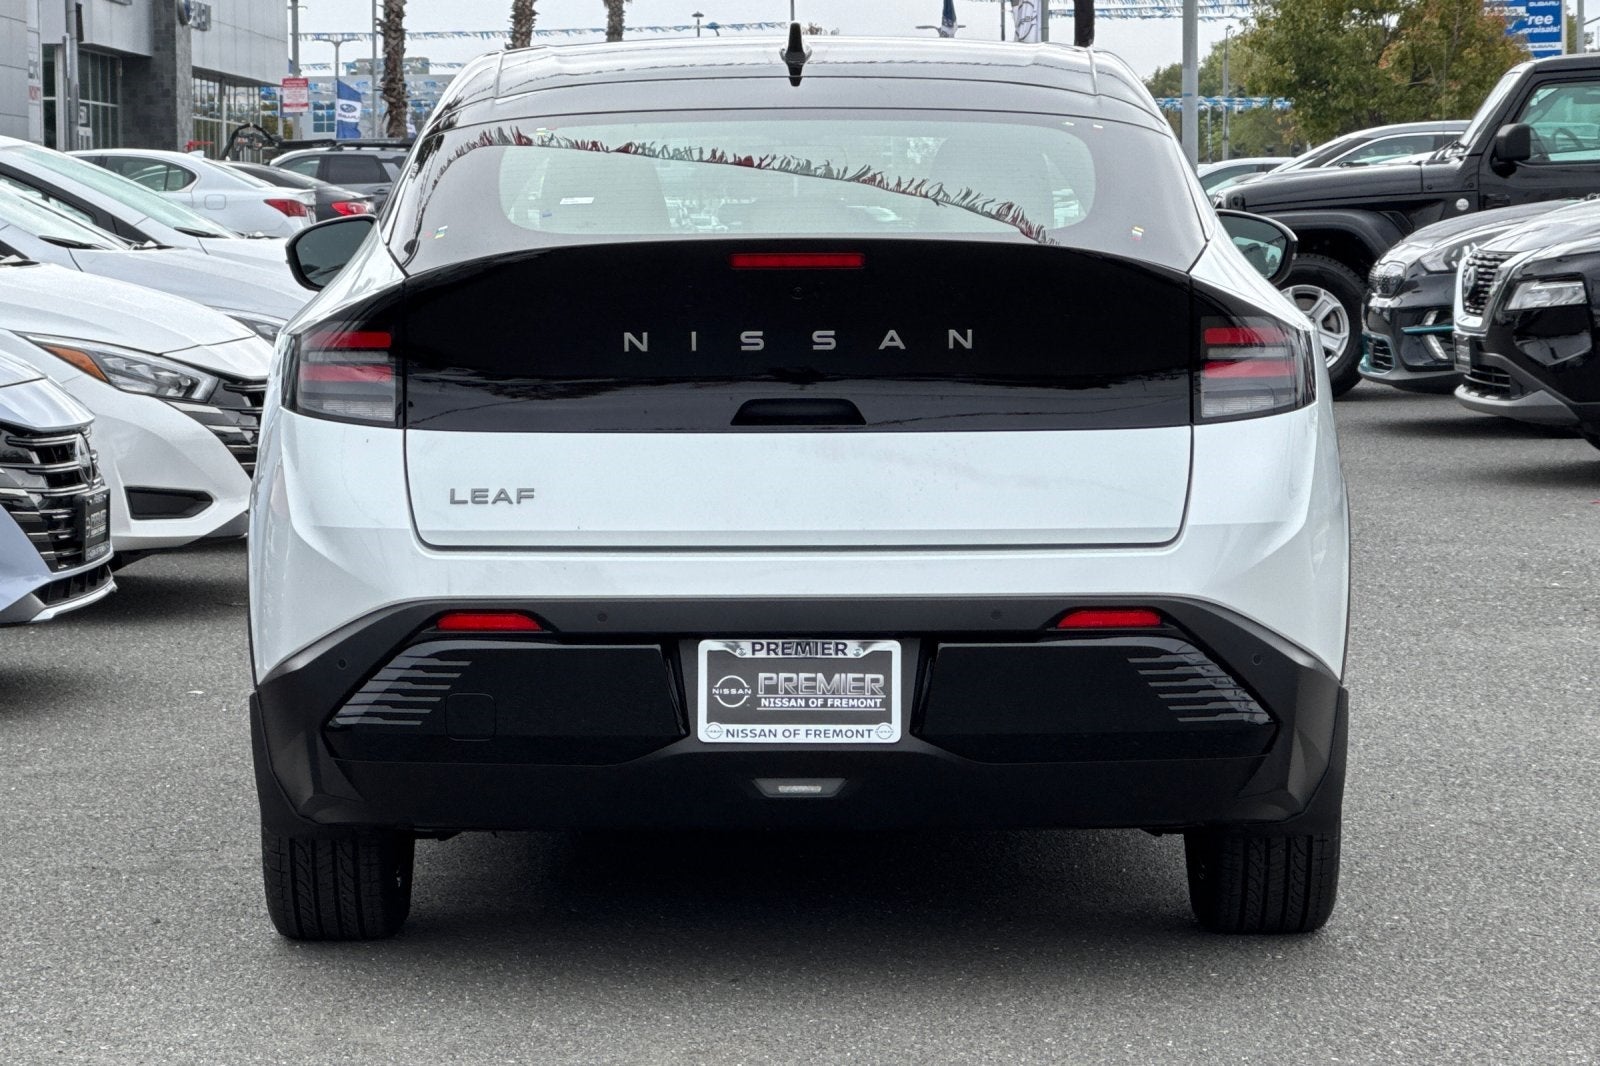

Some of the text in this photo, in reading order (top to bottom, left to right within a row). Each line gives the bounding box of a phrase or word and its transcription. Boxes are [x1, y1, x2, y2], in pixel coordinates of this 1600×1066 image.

[623, 329, 974, 352] NISSAN
[449, 488, 535, 505] LEAF
[751, 641, 849, 657] PREMIER
[757, 672, 885, 696] PREMIER
[760, 698, 882, 708] NISSAN OF FREMONT
[725, 728, 777, 739] NISSAN
[781, 728, 801, 739] OF
[805, 728, 874, 739] FREMONT
